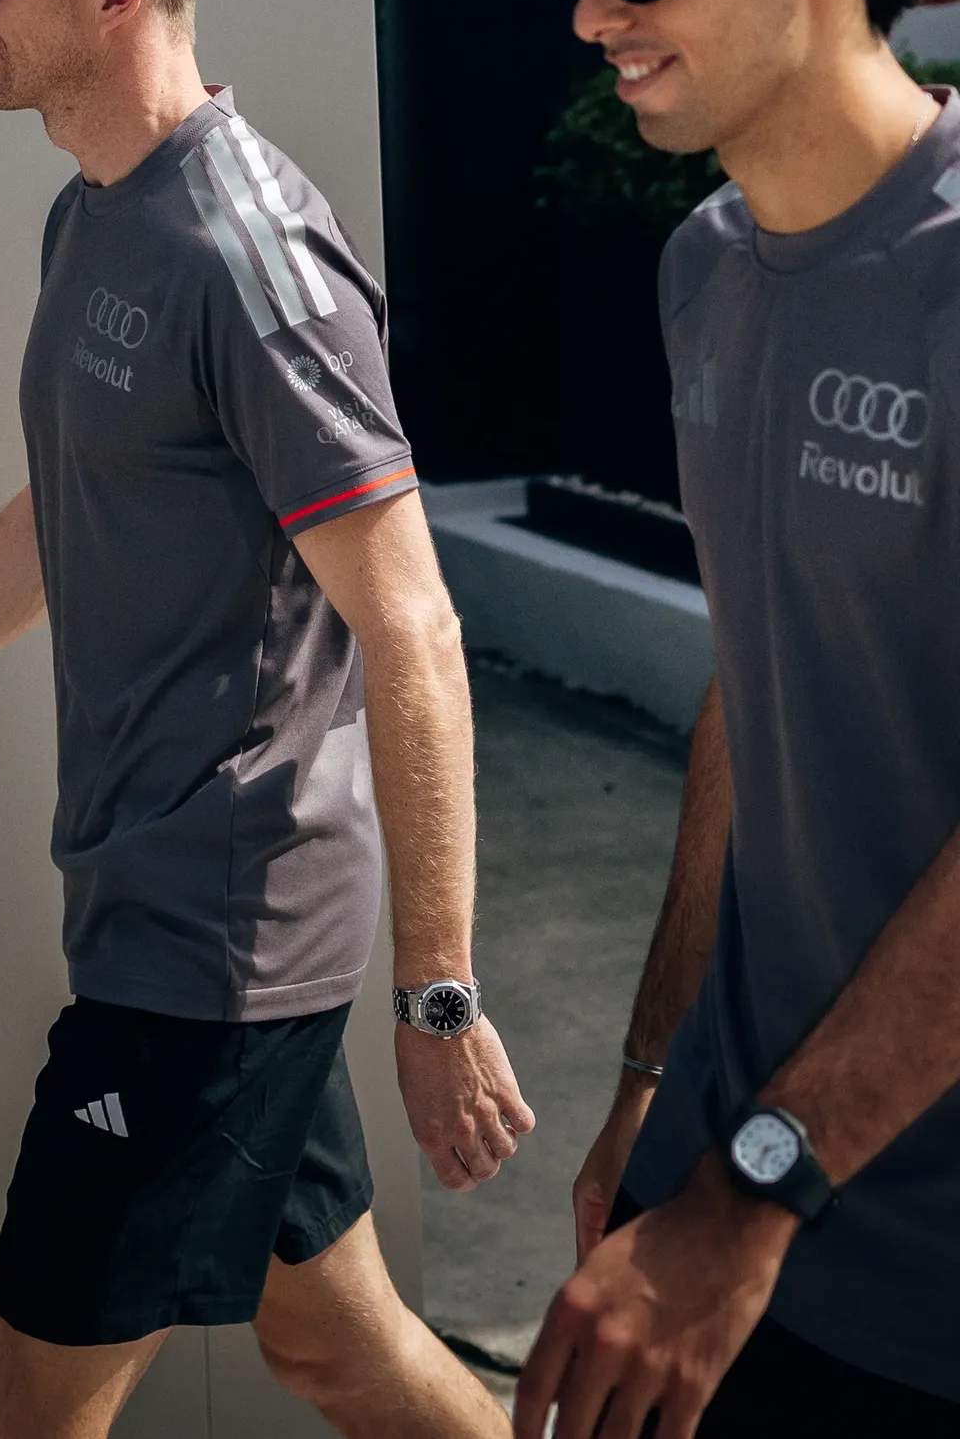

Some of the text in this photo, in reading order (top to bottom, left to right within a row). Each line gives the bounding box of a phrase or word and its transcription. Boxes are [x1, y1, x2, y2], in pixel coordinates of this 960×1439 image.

[71, 335, 134, 393] Revolut
[323, 350, 354, 374] bp
[327, 395, 373, 421] visit
[316, 411, 377, 444] QATAR
